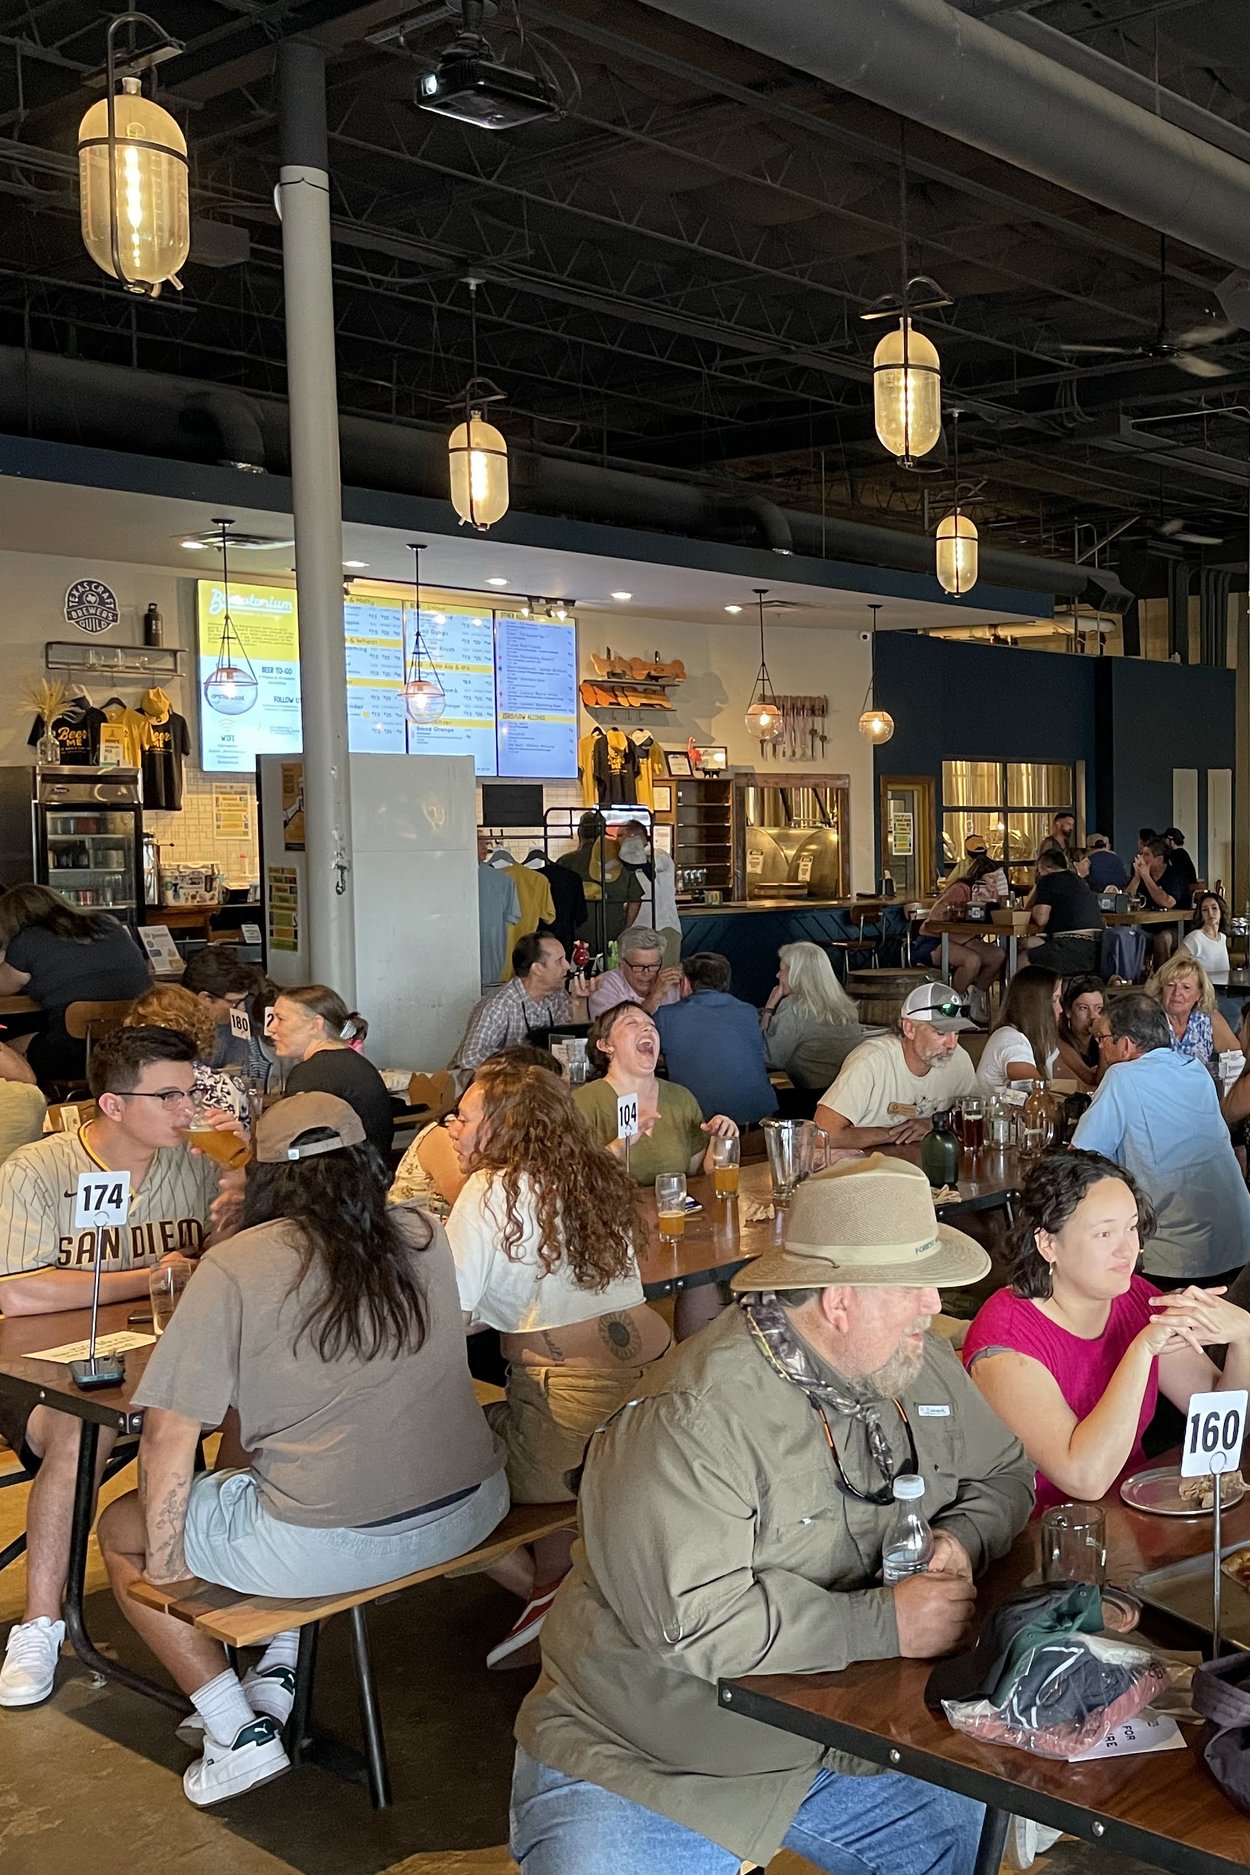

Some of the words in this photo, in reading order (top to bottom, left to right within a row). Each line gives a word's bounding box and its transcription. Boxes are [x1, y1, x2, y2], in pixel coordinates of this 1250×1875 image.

[69, 582, 90, 606] TEXAS
[91, 583, 115, 609] CRAFT
[71, 606, 113, 620] BREWERS
[79, 618, 108, 631] GUILD
[262, 666, 274, 674] BEER
[276, 667, 293, 675] TO-GO
[274, 695, 294, 703] FOLLOW
[58, 726, 88, 740] Beer
[66, 739, 83, 747] ME
[231, 1014, 248, 1032] 180
[620, 1102, 637, 1126] 104
[83, 1183, 123, 1211] 174
[57, 1226, 120, 1266] SAN
[1190, 1409, 1240, 1454] 160
[1122, 1725, 1136, 1741] FOR
